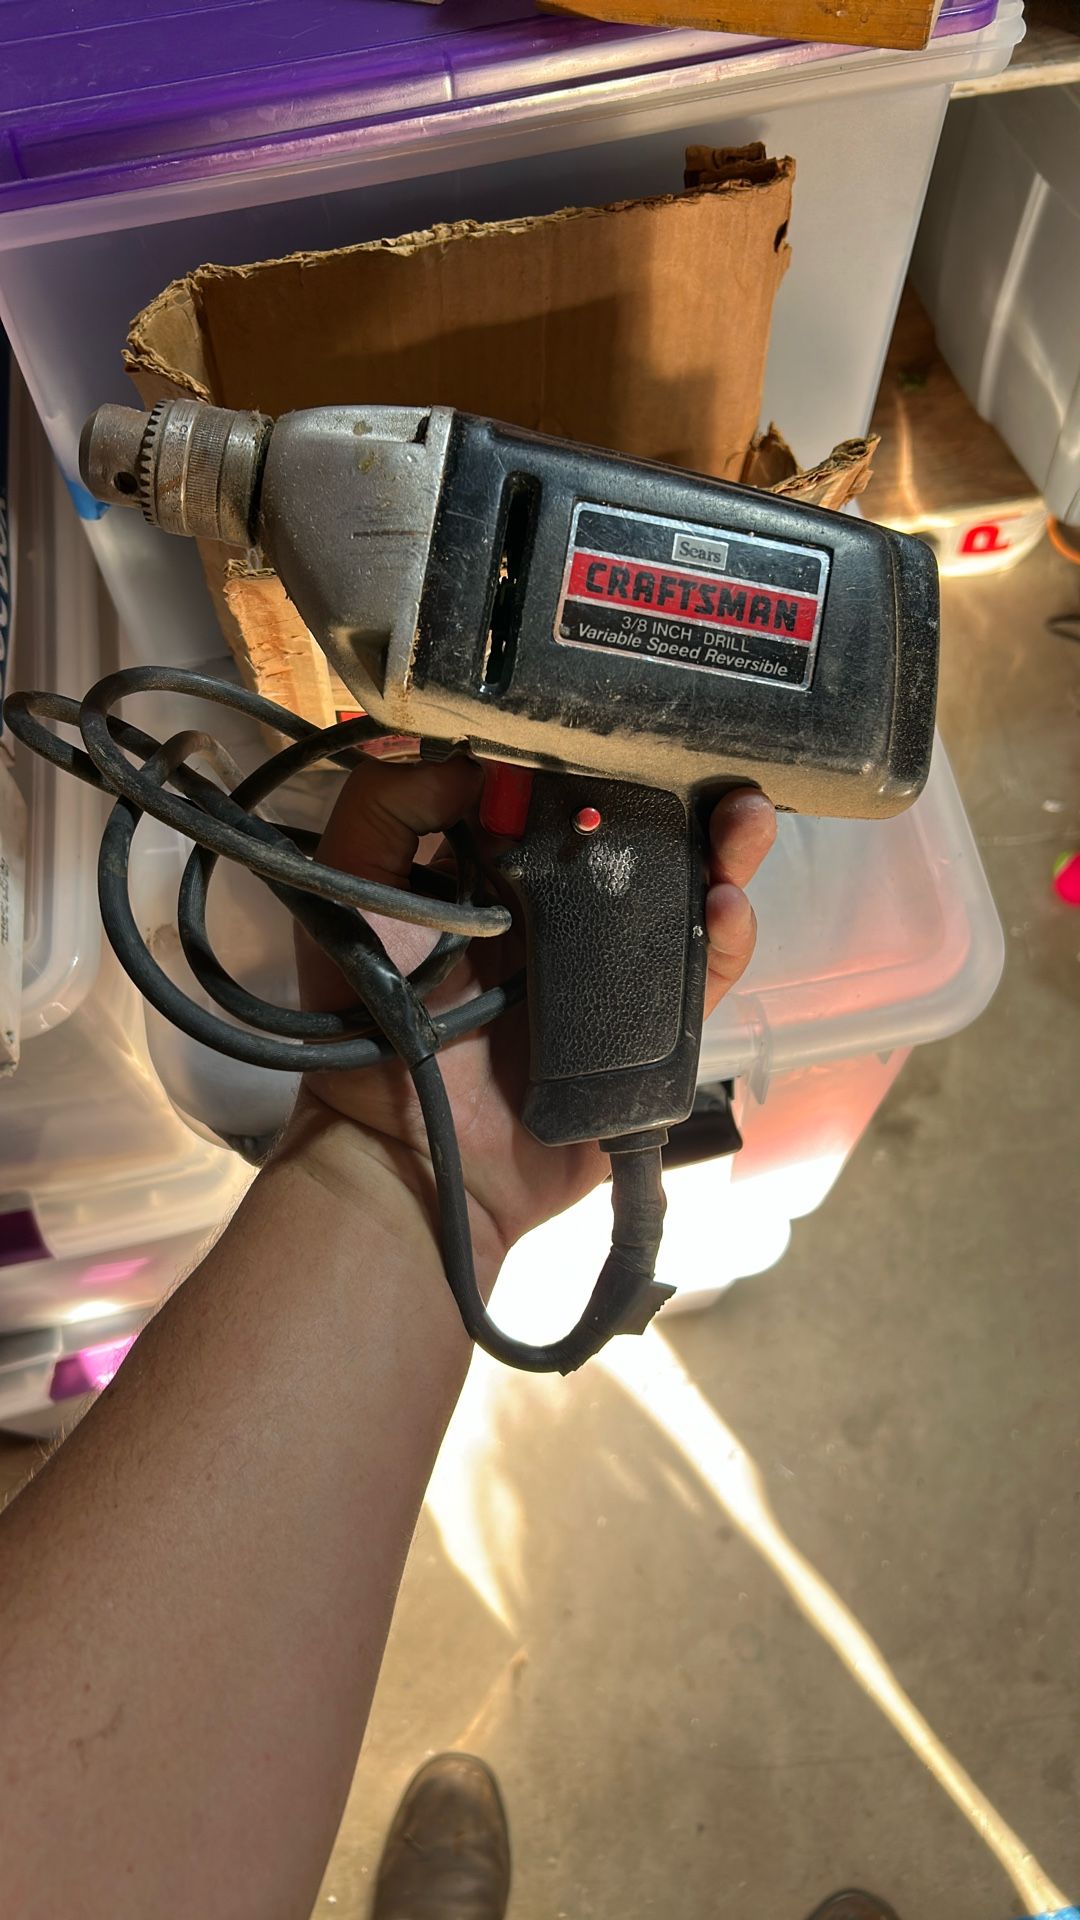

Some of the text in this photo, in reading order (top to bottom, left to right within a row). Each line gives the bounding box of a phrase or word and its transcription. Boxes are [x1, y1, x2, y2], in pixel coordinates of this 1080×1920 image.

[679, 541, 722, 564] Sears
[586, 563, 798, 631] CRAFTSMAN
[577, 622, 789, 677] Variable Speed Reversible
[621, 616, 750, 653] 3/8 INCH DRILL
